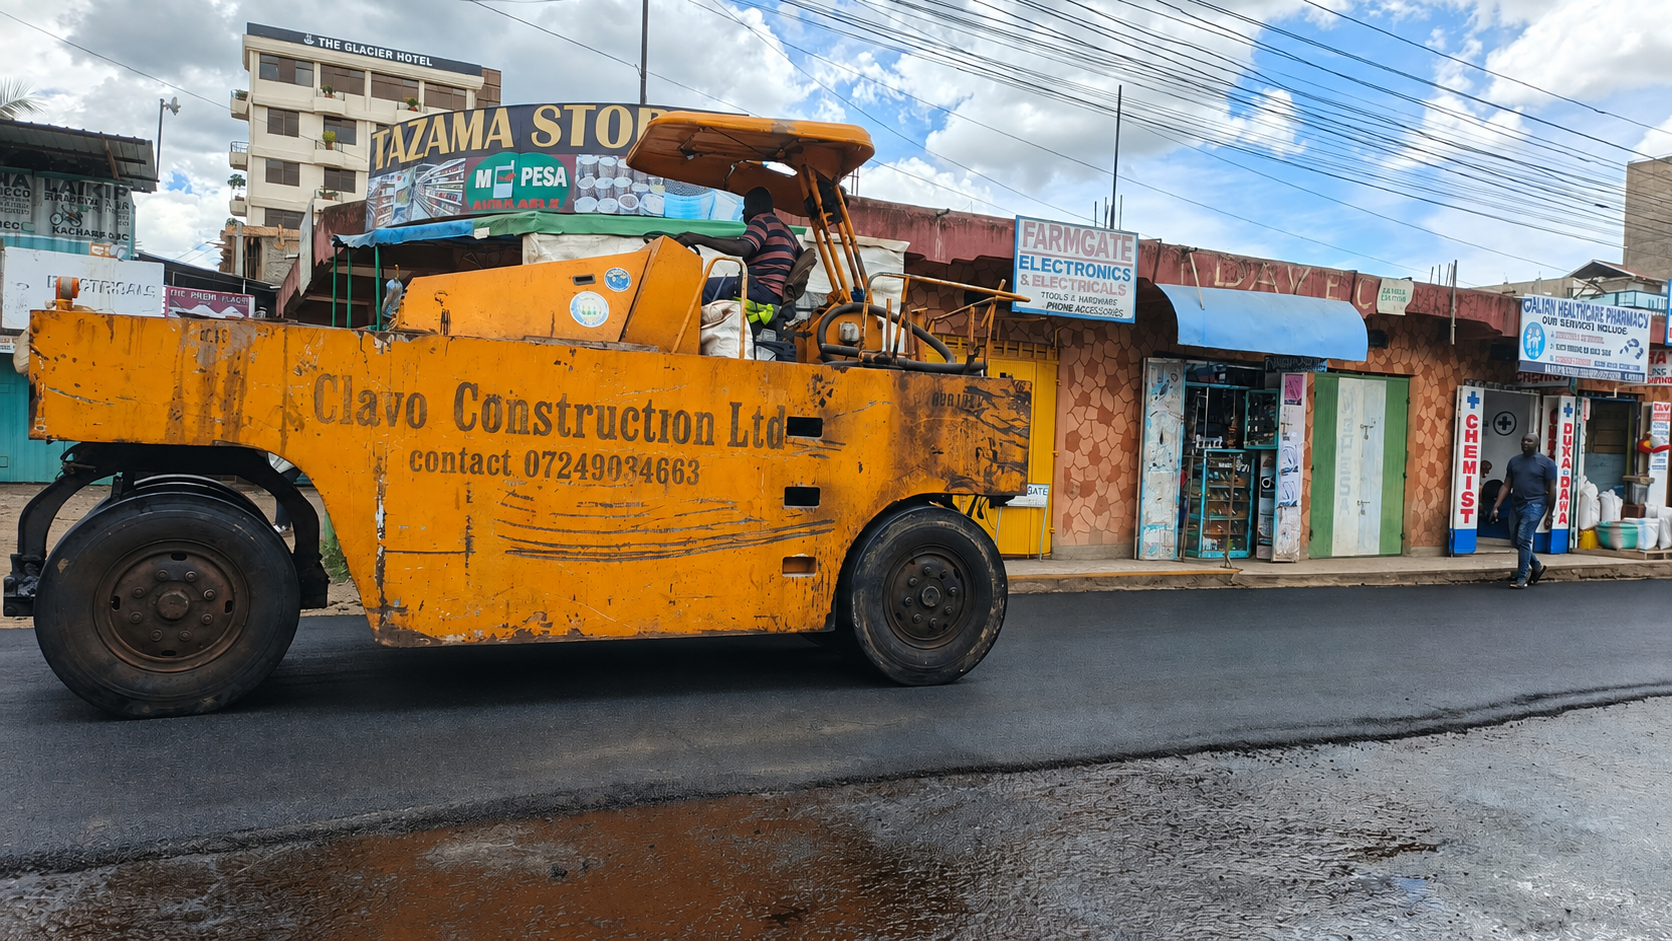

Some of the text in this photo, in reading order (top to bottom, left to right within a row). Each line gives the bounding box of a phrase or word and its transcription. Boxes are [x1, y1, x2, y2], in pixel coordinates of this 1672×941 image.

[318, 37, 433, 67] THE GLACIER HOTEL
[371, 107, 515, 171] TAZAMA
[521, 166, 567, 187] PESA
[1022, 221, 1133, 262] FARMGATE
[1019, 255, 1131, 282] ELECTRONICS
[1020, 274, 1126, 297] & ELECTRICALS
[1046, 301, 1074, 312] PHONE
[1558, 299, 1604, 323] HEALTHCARE
[1606, 307, 1650, 329] PHARMACY
[313, 373, 785, 451] Clavo Construction Ltd
[409, 446, 513, 477] contact
[1460, 414, 1479, 524] CHEMIST
